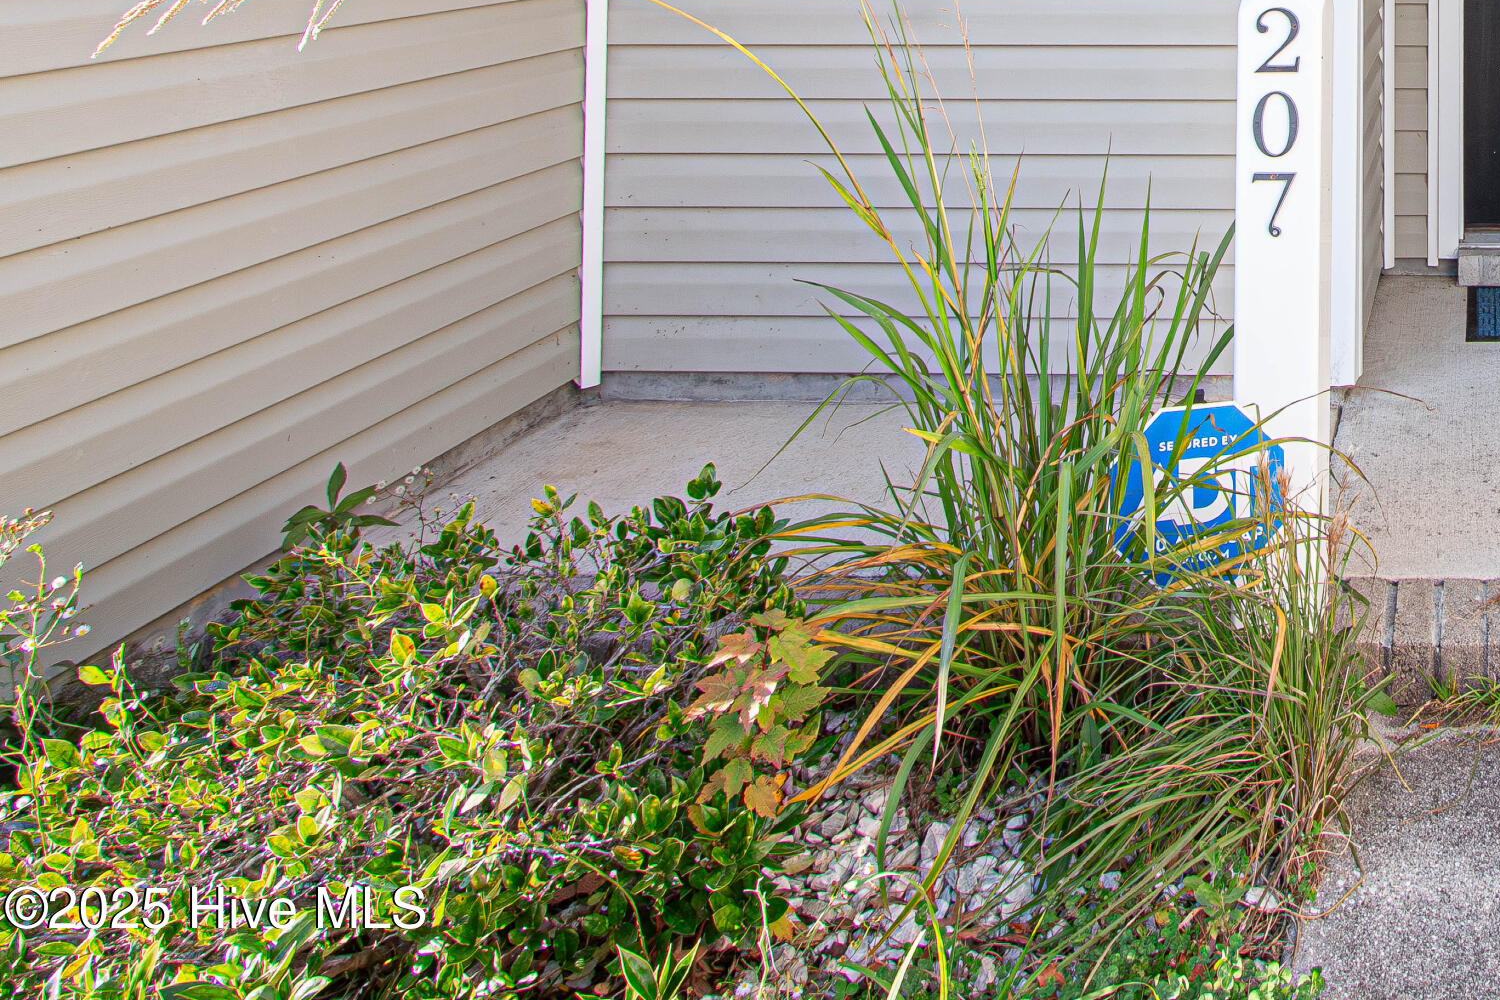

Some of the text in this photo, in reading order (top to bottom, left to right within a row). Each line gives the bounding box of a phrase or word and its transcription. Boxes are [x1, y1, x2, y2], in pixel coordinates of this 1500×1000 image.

[1252, 7, 1300, 237] 207
[1158, 437, 1218, 452] SERED
[1128, 449, 1269, 534] ADT
